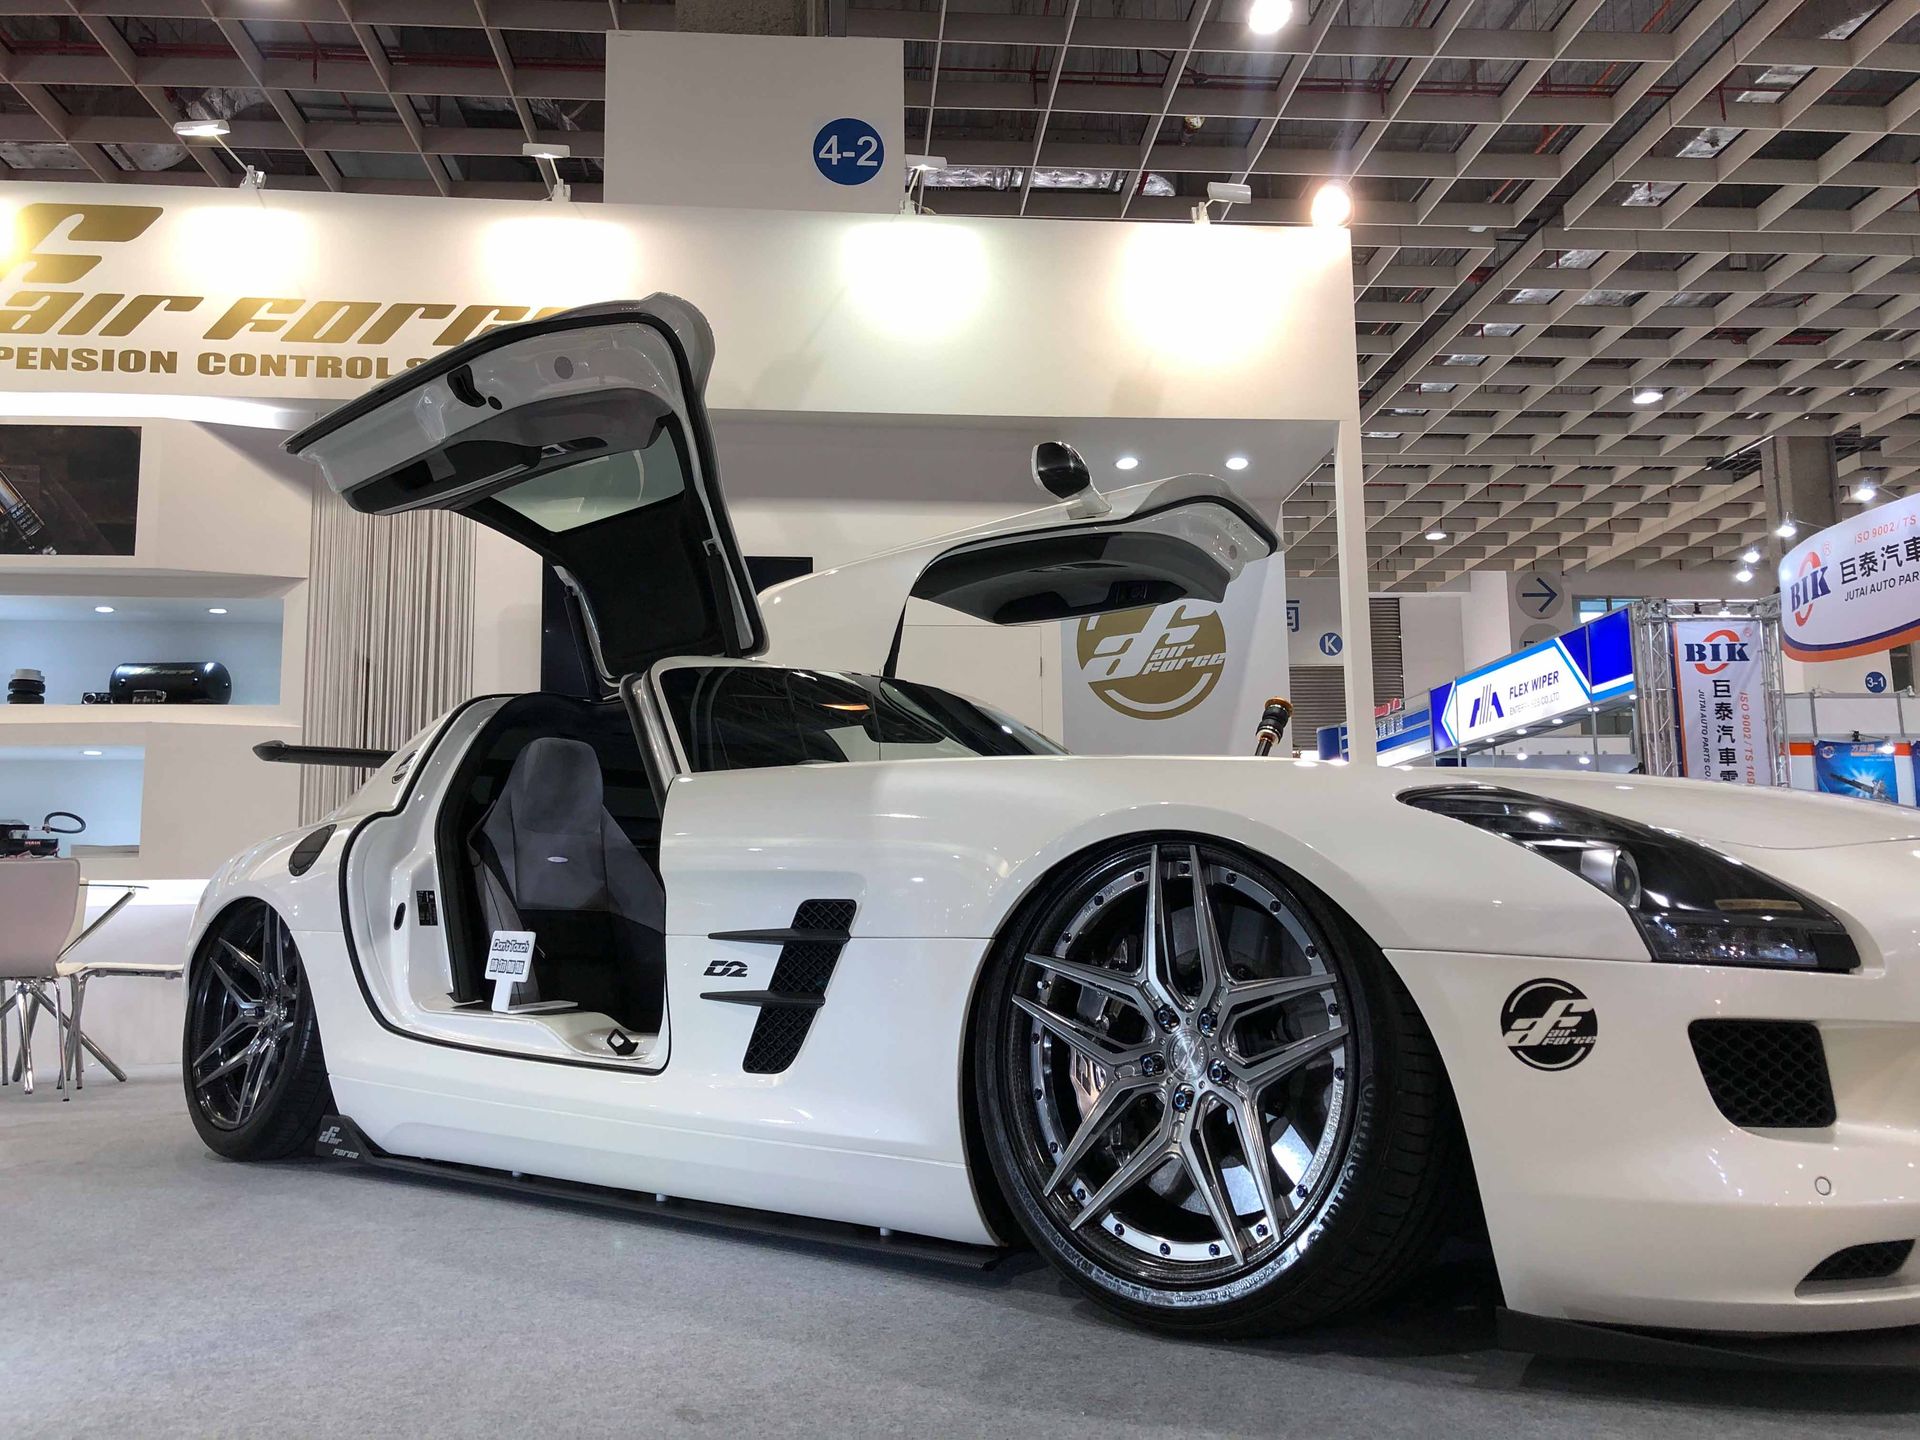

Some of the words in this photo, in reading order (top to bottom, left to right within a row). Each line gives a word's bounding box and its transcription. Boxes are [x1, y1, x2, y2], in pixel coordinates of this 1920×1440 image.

[819, 135, 878, 166] 4-2
[1855, 530, 1870, 544] ISO
[1872, 522, 1895, 537] 9002
[1790, 566, 1831, 613] BIK
[1844, 585, 1868, 602] JUTAI
[1870, 577, 1896, 594] AUTO
[1899, 571, 1920, 586] PAR
[1324, 635, 1338, 653] K
[1684, 642, 1750, 662] BIK
[1509, 681, 1529, 700] FLEX
[1531, 670, 1559, 691] WIPER
[1866, 676, 1885, 688] 3-1
[1698, 689, 1706, 712] JUTAI
[1699, 712, 1708, 736] AUTO
[1742, 714, 1751, 740] 9002
[1702, 737, 1711, 764] PARTS
[703, 960, 748, 977] D2
